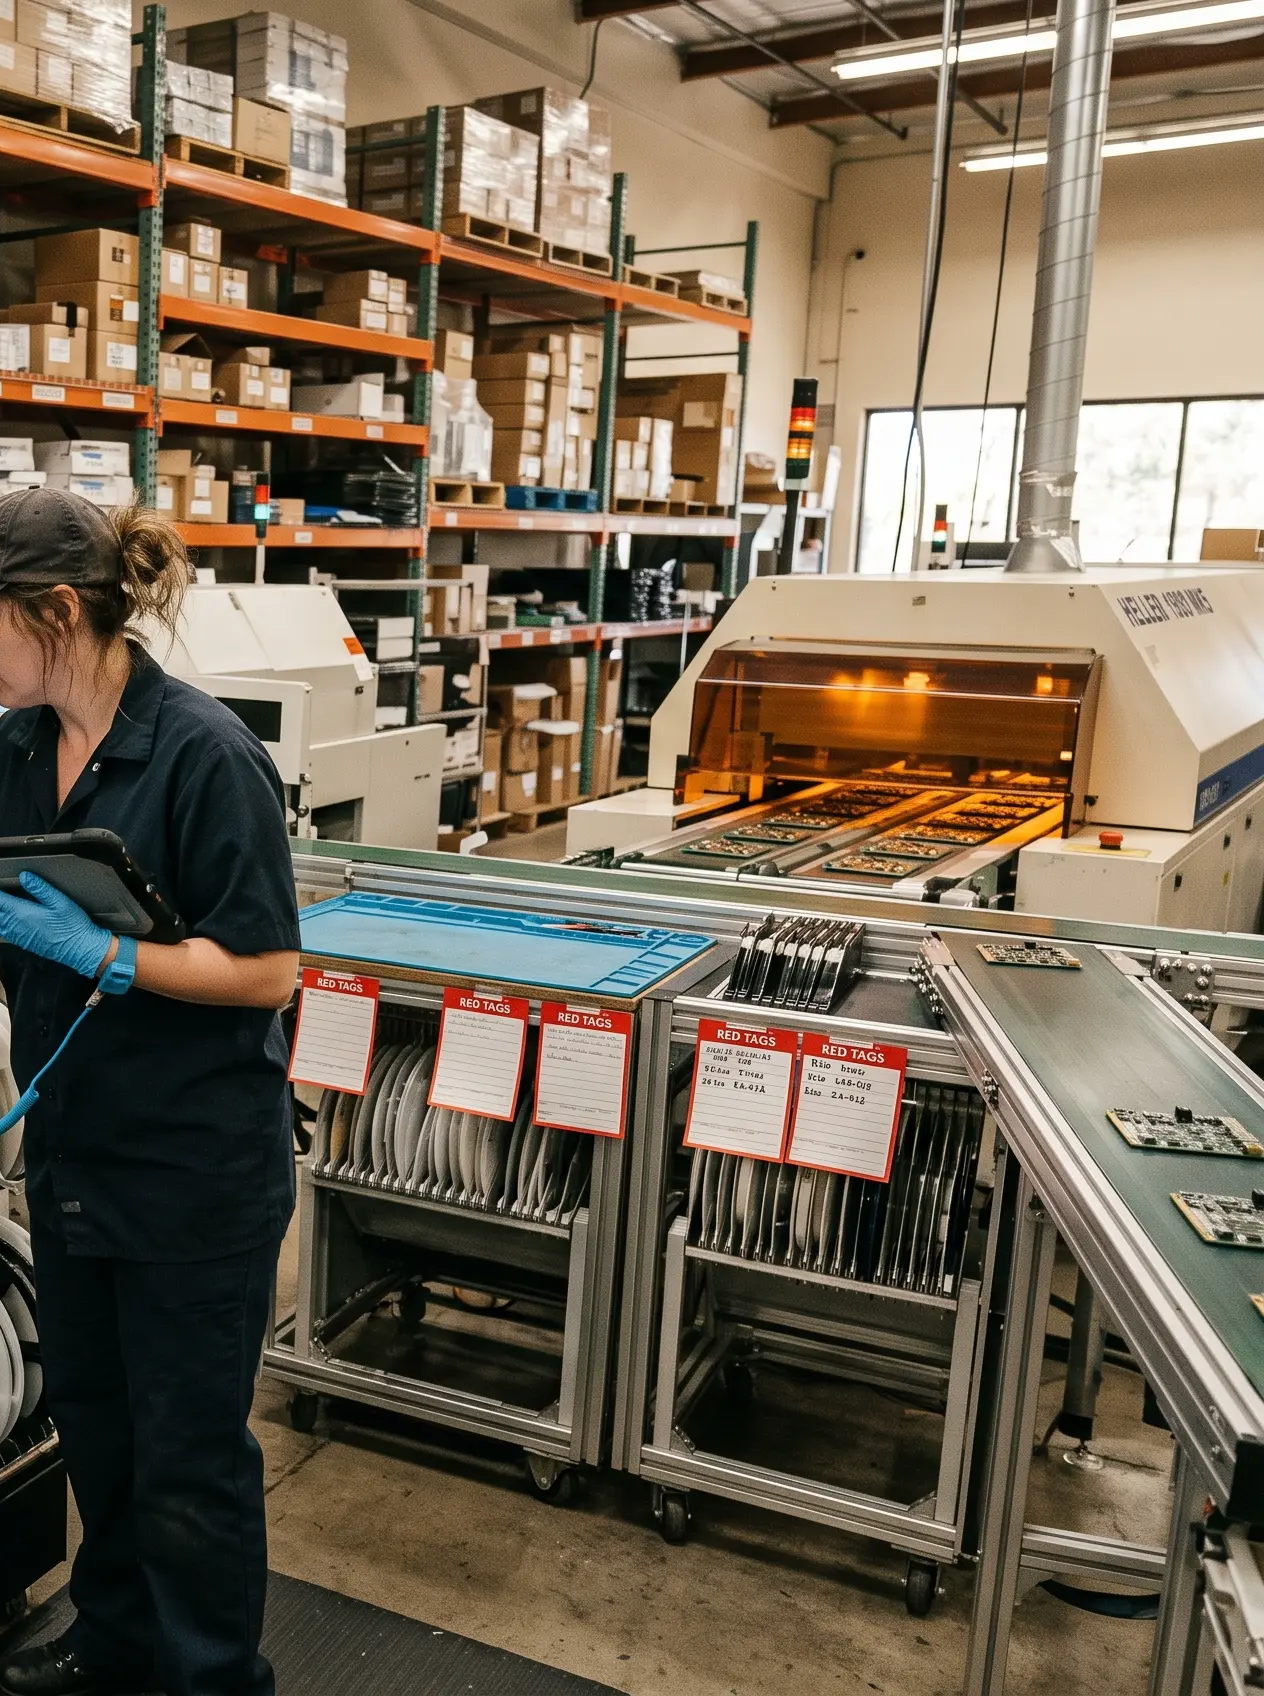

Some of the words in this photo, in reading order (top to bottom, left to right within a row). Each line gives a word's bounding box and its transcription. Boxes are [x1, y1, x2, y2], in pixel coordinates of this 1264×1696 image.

[317, 976, 337, 989] RED
[338, 980, 364, 993] TAGS
[483, 999, 511, 1015] TAGS
[558, 1012, 580, 1024] RED
[582, 1015, 613, 1029] TAGS
[717, 1029, 741, 1041] RED
[744, 1033, 776, 1047] TAGS
[821, 1044, 851, 1058] RED
[855, 1048, 885, 1064] TAGS
